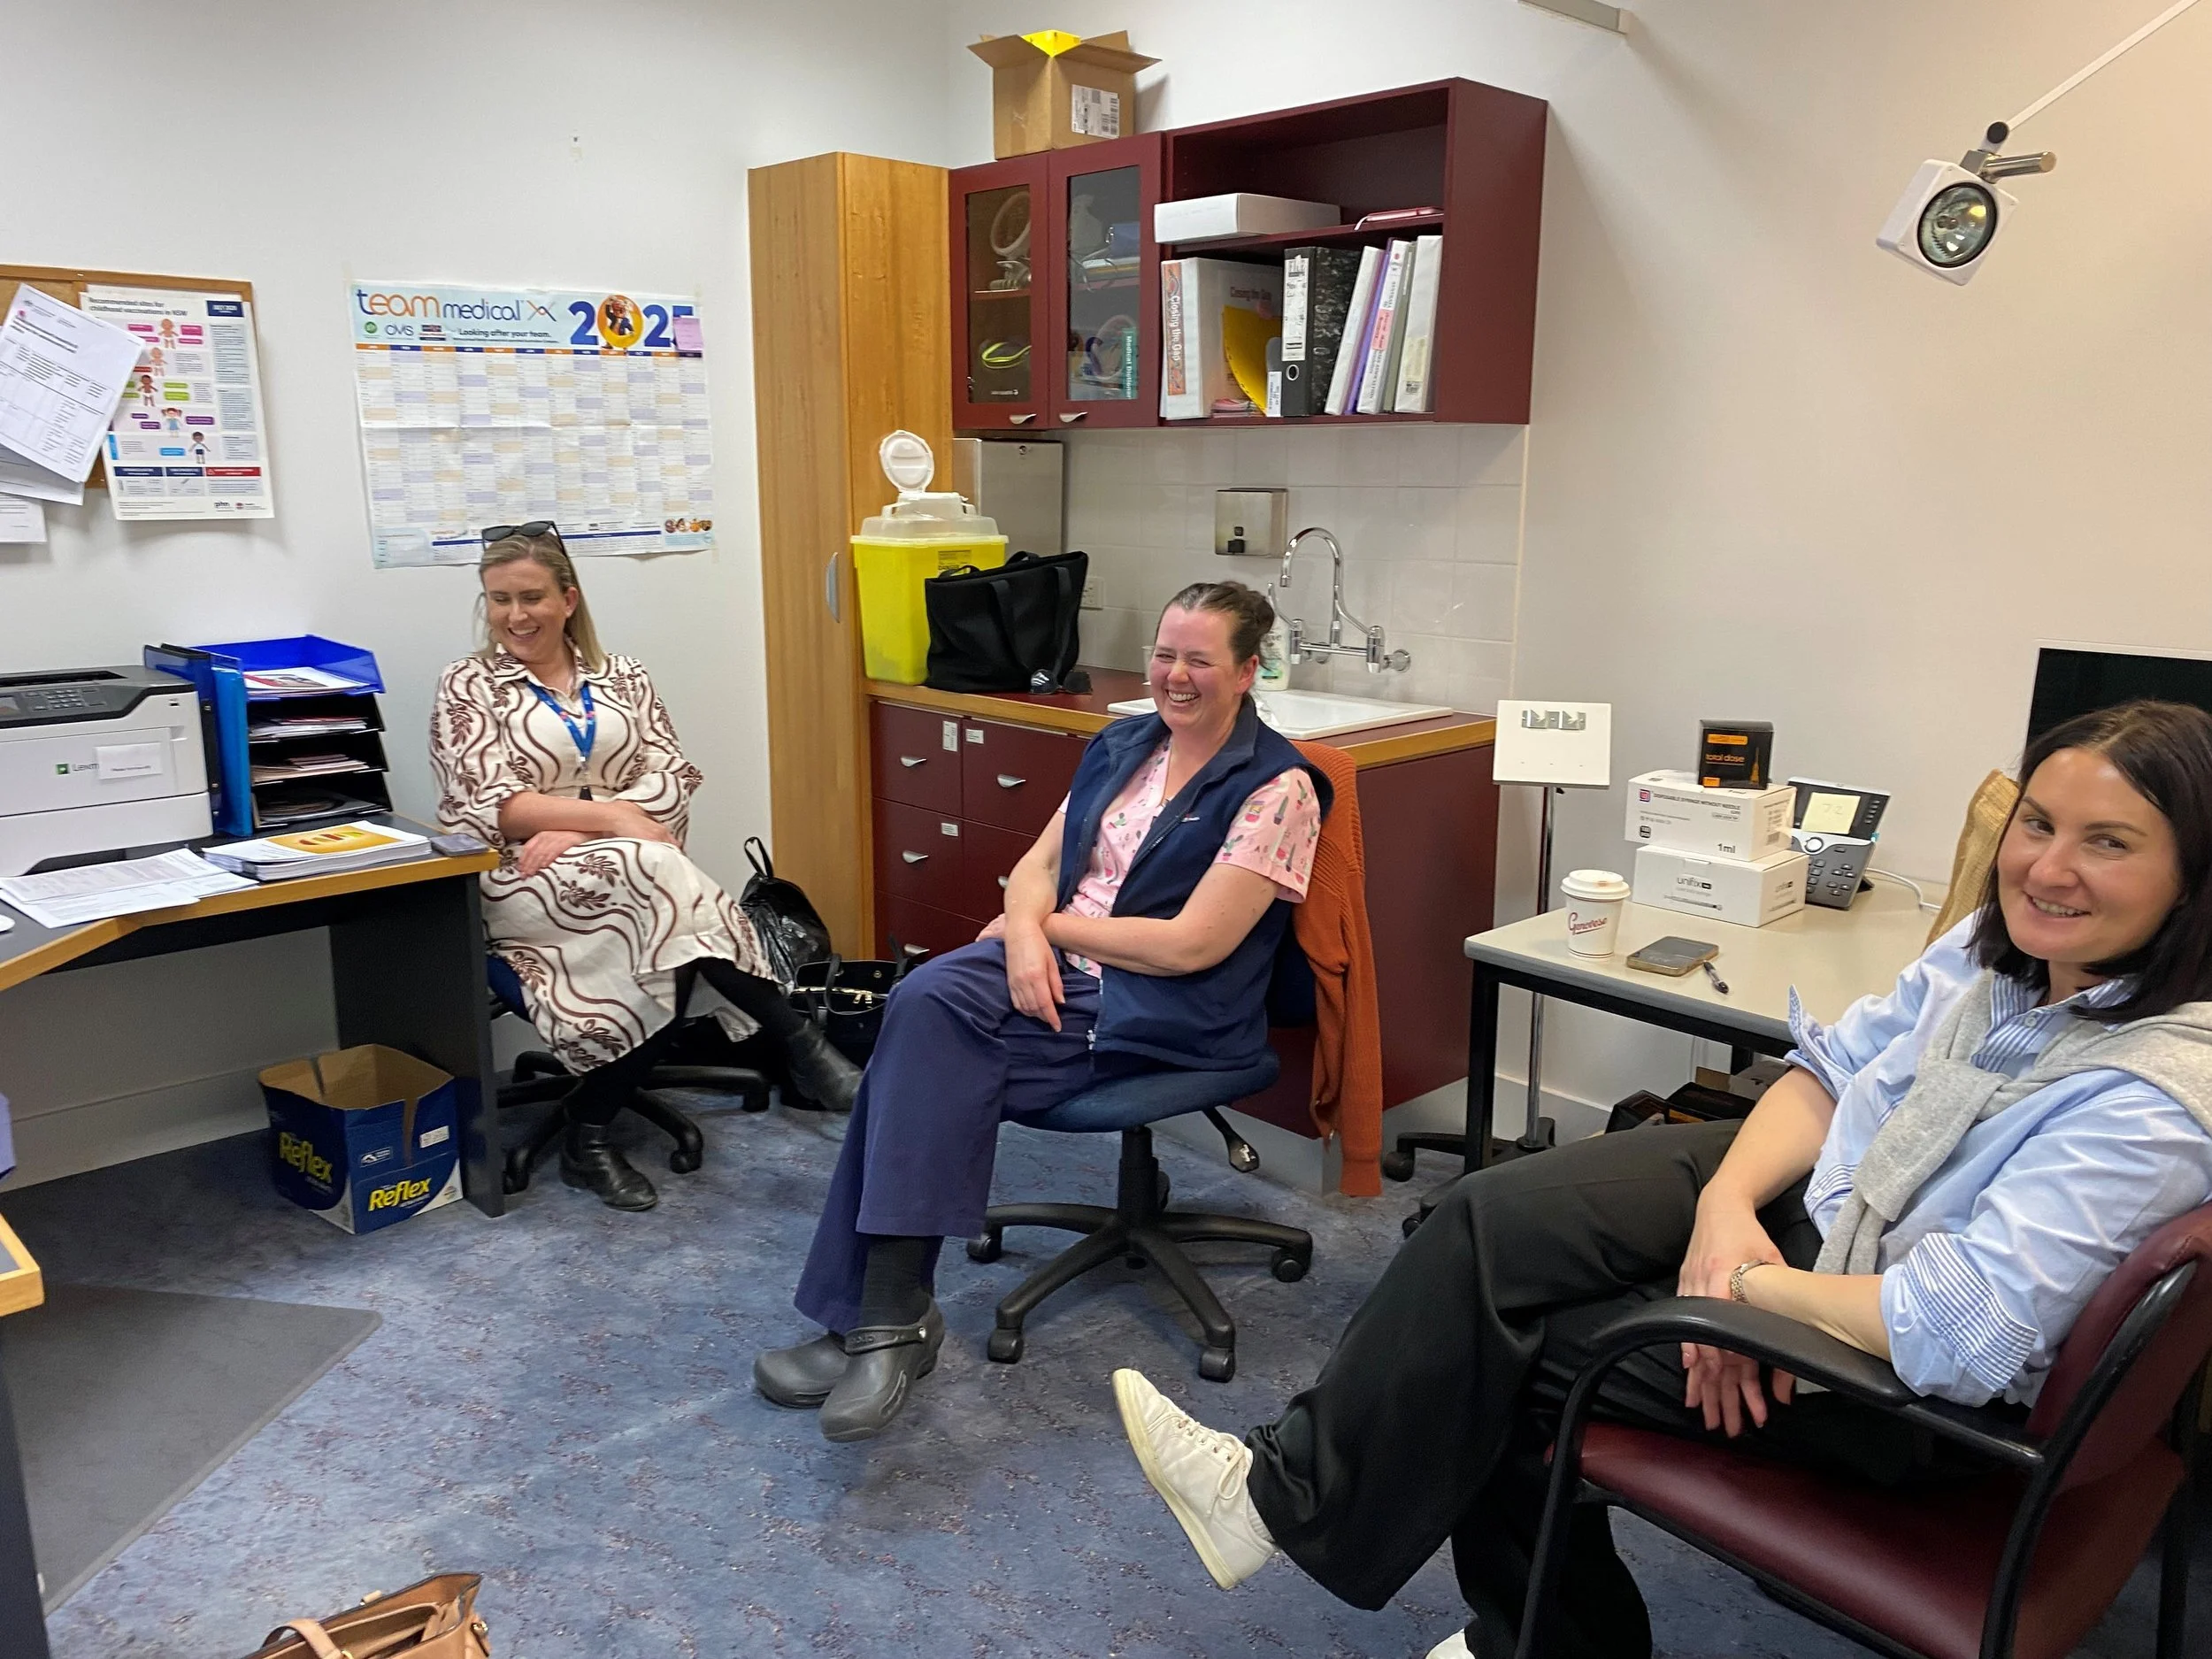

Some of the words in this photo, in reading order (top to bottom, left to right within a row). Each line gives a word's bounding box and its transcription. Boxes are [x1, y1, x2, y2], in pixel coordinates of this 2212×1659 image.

[357, 289, 441, 319] team
[442, 298, 520, 321] medical
[1170, 296, 1180, 327] Closing
[459, 328, 488, 338] Looking
[1171, 328, 1182, 342] the
[1171, 343, 1182, 362] Gap
[1724, 753, 1746, 763] dose
[72, 763, 100, 772] Lexm
[1717, 843, 1736, 854] 1ml
[1677, 877, 1702, 888] unifix
[280, 1132, 333, 1184] Reflex
[368, 1178, 432, 1211] Reflex
